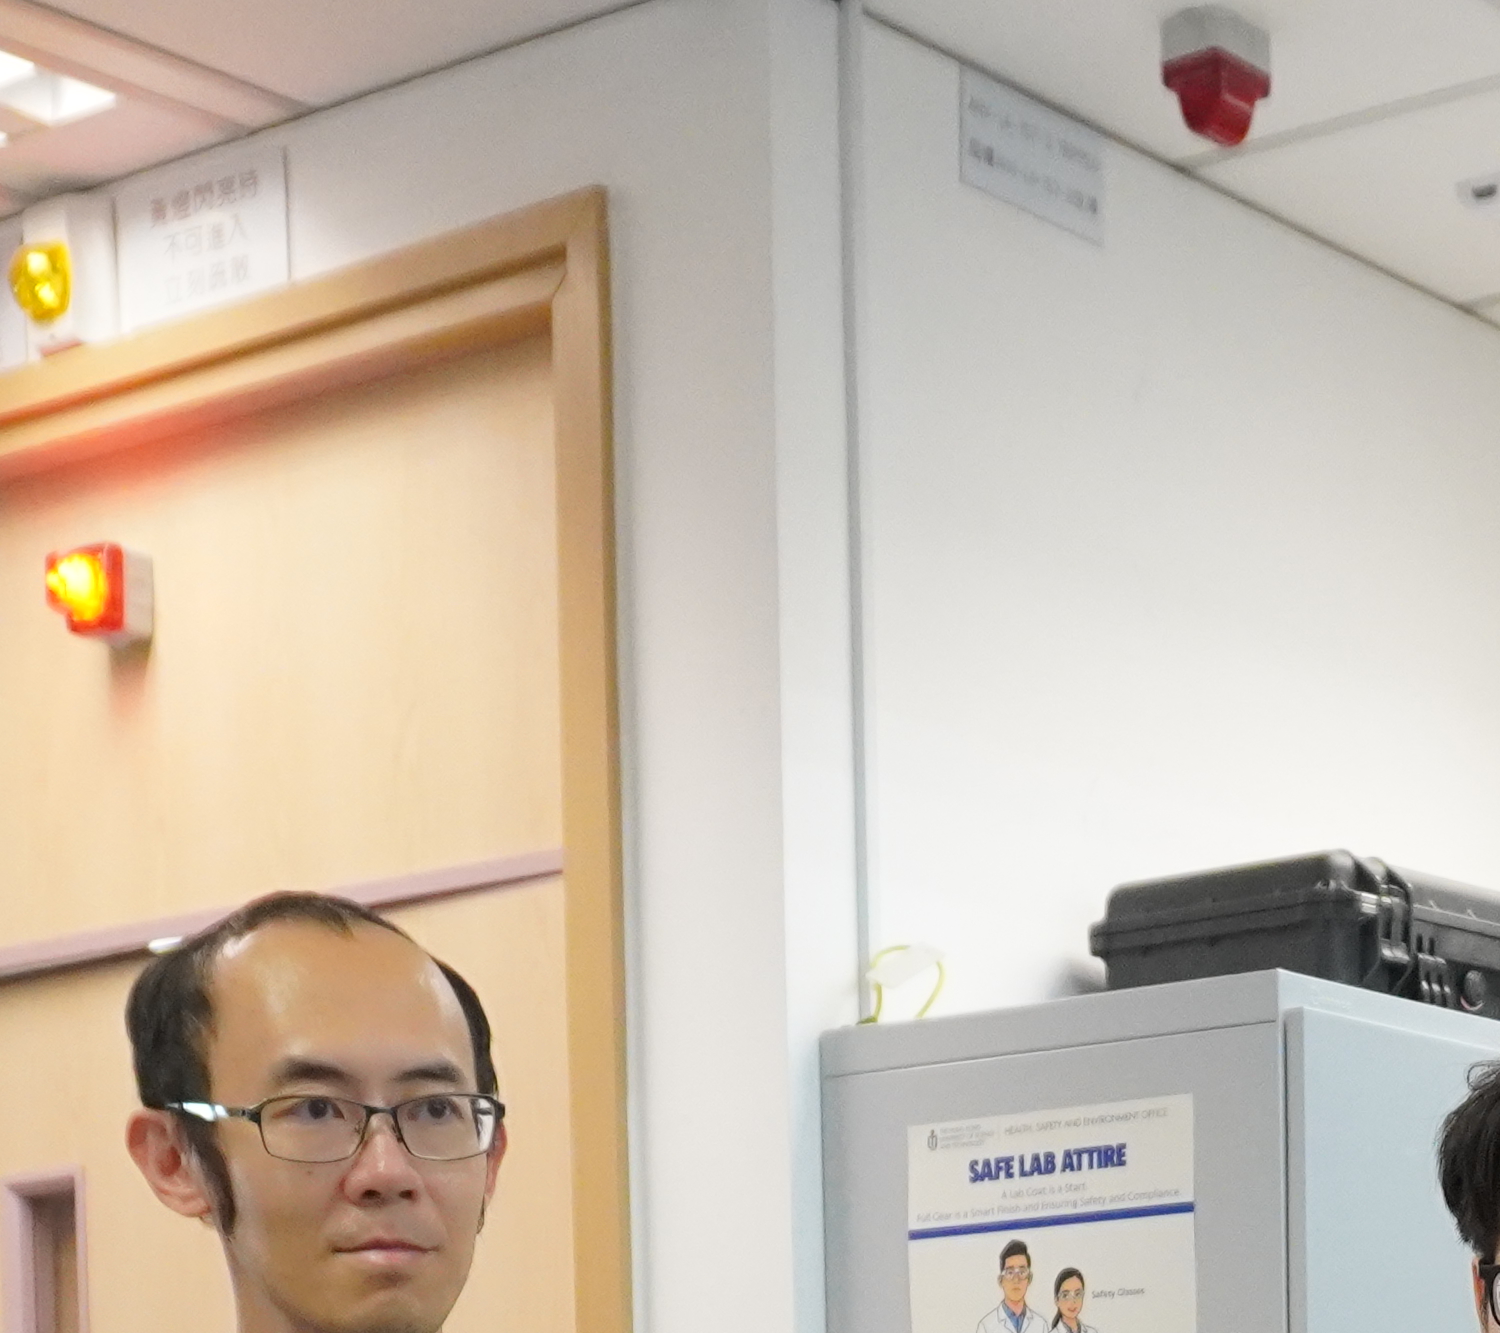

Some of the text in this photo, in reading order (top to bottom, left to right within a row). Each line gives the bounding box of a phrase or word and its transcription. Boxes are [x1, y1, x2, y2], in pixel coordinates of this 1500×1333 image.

[1142, 1107, 1168, 1119] OFFICE
[969, 1142, 1127, 1183] SAFE LAB ATTIRE
[1001, 1190, 1008, 1199] A
[1010, 1189, 1024, 1199] Lab
[1025, 1186, 1046, 1197] Coat
[932, 1211, 952, 1221] Gear
[970, 1207, 994, 1217] Smart
[997, 1204, 1020, 1215] Finish
[1022, 1201, 1039, 1212] and
[1041, 1198, 1078, 1210] Ensuring
[1080, 1195, 1106, 1207] Safety
[1109, 1193, 1125, 1203] and
[1091, 1290, 1115, 1299] Safety
